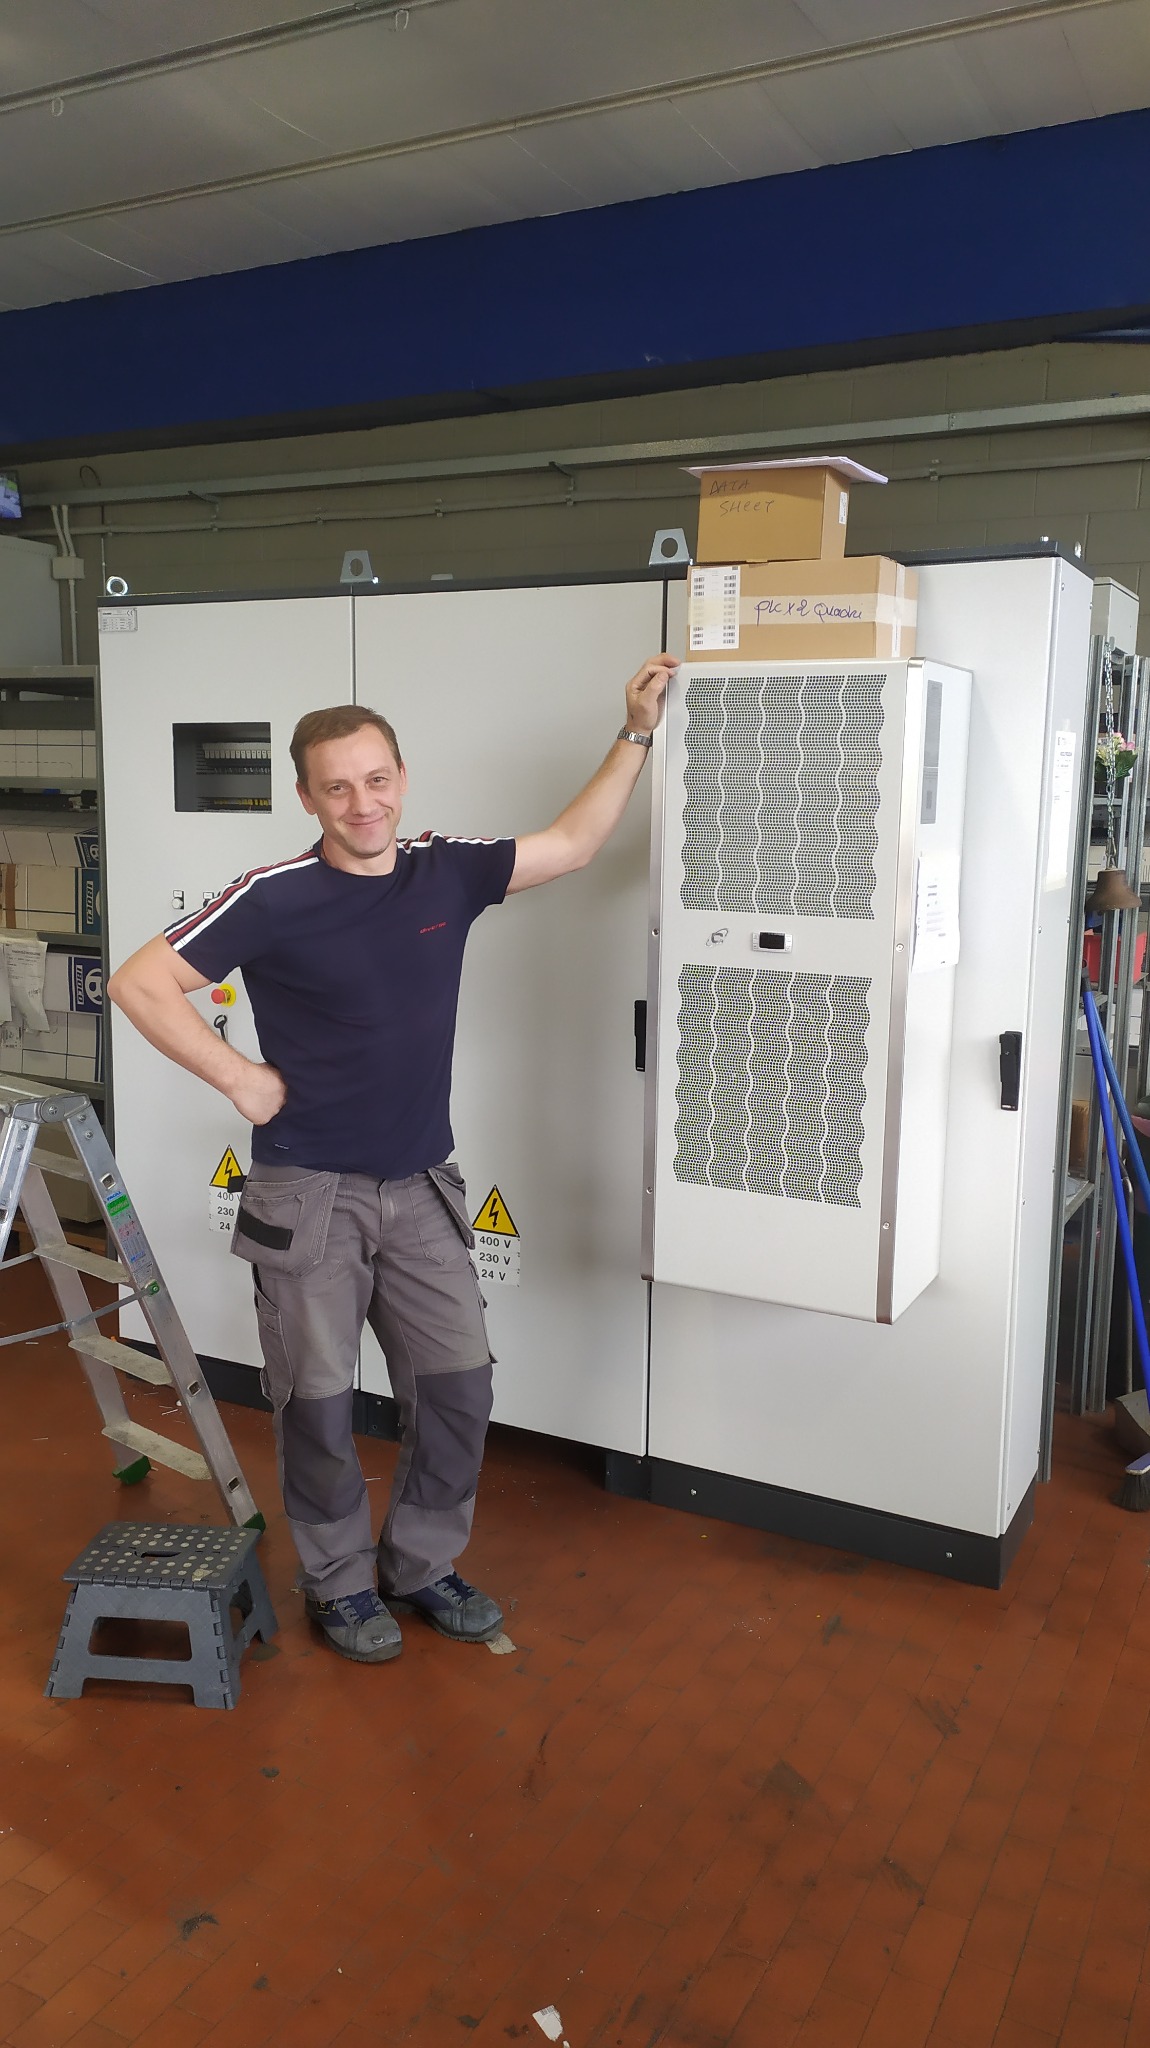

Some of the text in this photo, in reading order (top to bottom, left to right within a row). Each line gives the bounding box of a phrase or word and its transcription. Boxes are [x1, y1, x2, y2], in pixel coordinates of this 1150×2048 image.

[76, 966, 84, 1004] IBOCO
[217, 1191, 234, 1201] 400
[217, 1206, 234, 1217] 230
[220, 1222, 230, 1231] 24
[480, 1236, 511, 1249] 400 V
[479, 1252, 510, 1265] 230 V
[482, 1269, 506, 1281] 24 V
